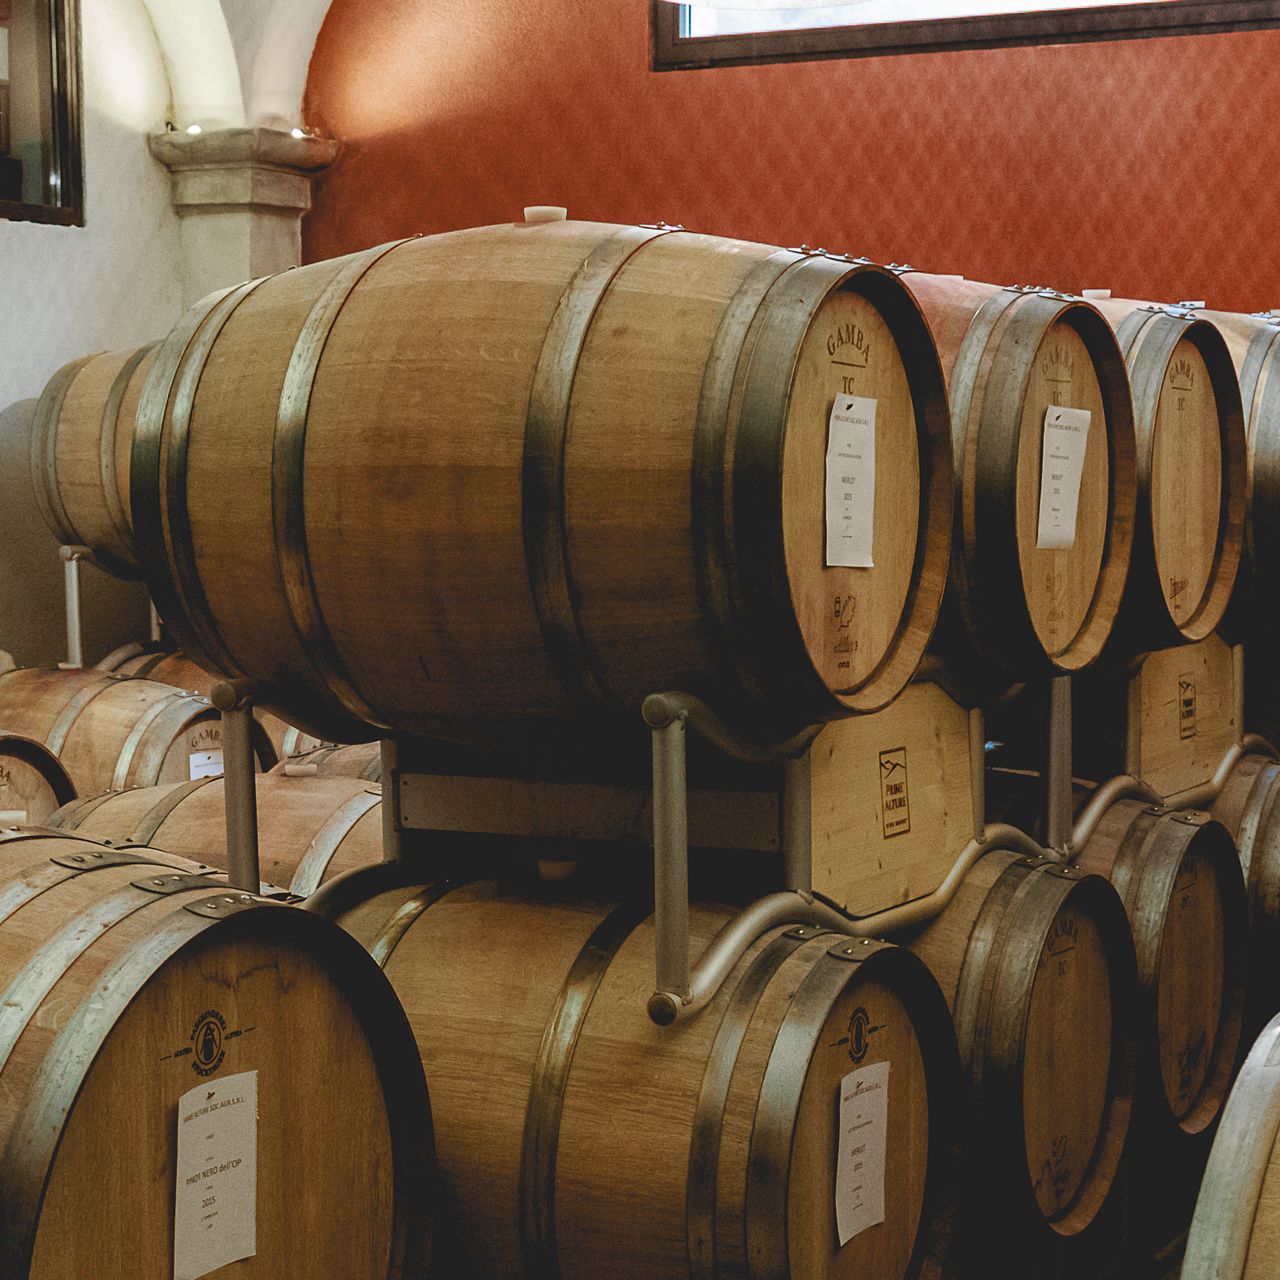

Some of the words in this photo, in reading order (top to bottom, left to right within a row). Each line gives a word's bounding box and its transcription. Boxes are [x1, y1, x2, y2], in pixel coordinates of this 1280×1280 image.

[827, 323, 870, 364] GAMBA
[1170, 359, 1194, 388] GAMBA
[842, 376, 855, 395] TC
[885, 796, 907, 812] ALTURE
[186, 1172, 201, 1185] PINOT
[202, 1166, 218, 1178] NERO
[202, 1195, 216, 1208] 2015
